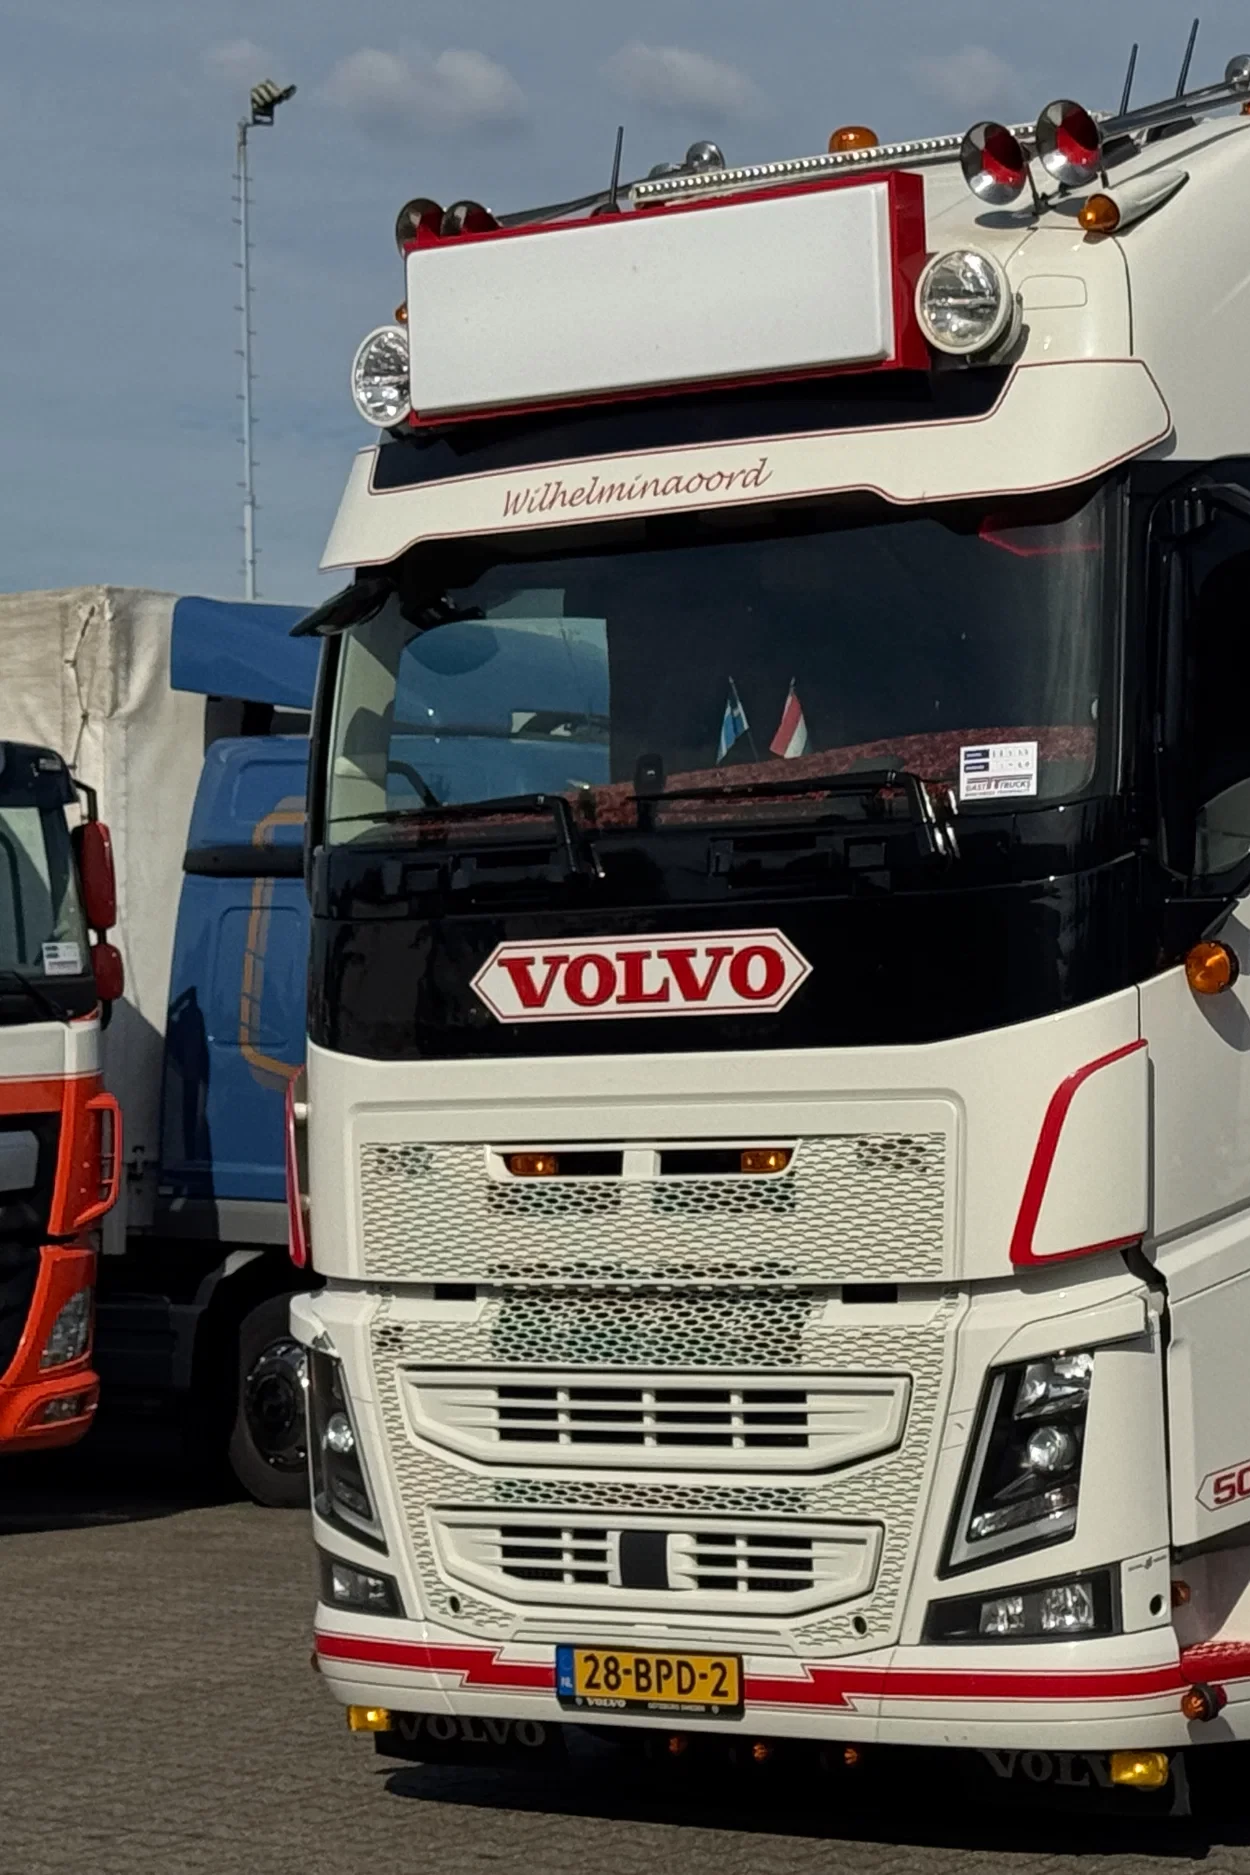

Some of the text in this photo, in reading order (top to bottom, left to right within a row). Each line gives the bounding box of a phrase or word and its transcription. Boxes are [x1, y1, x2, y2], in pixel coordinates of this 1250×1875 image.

[502, 457, 773, 517] Wilhelminaoord
[498, 945, 786, 1008] VOLVO
[582, 1653, 729, 1697] 28-BPD-2
[586, 1697, 627, 1708] VOLVO
[397, 1713, 546, 1747] VOLVO
[978, 1748, 1160, 1791] VOLV
